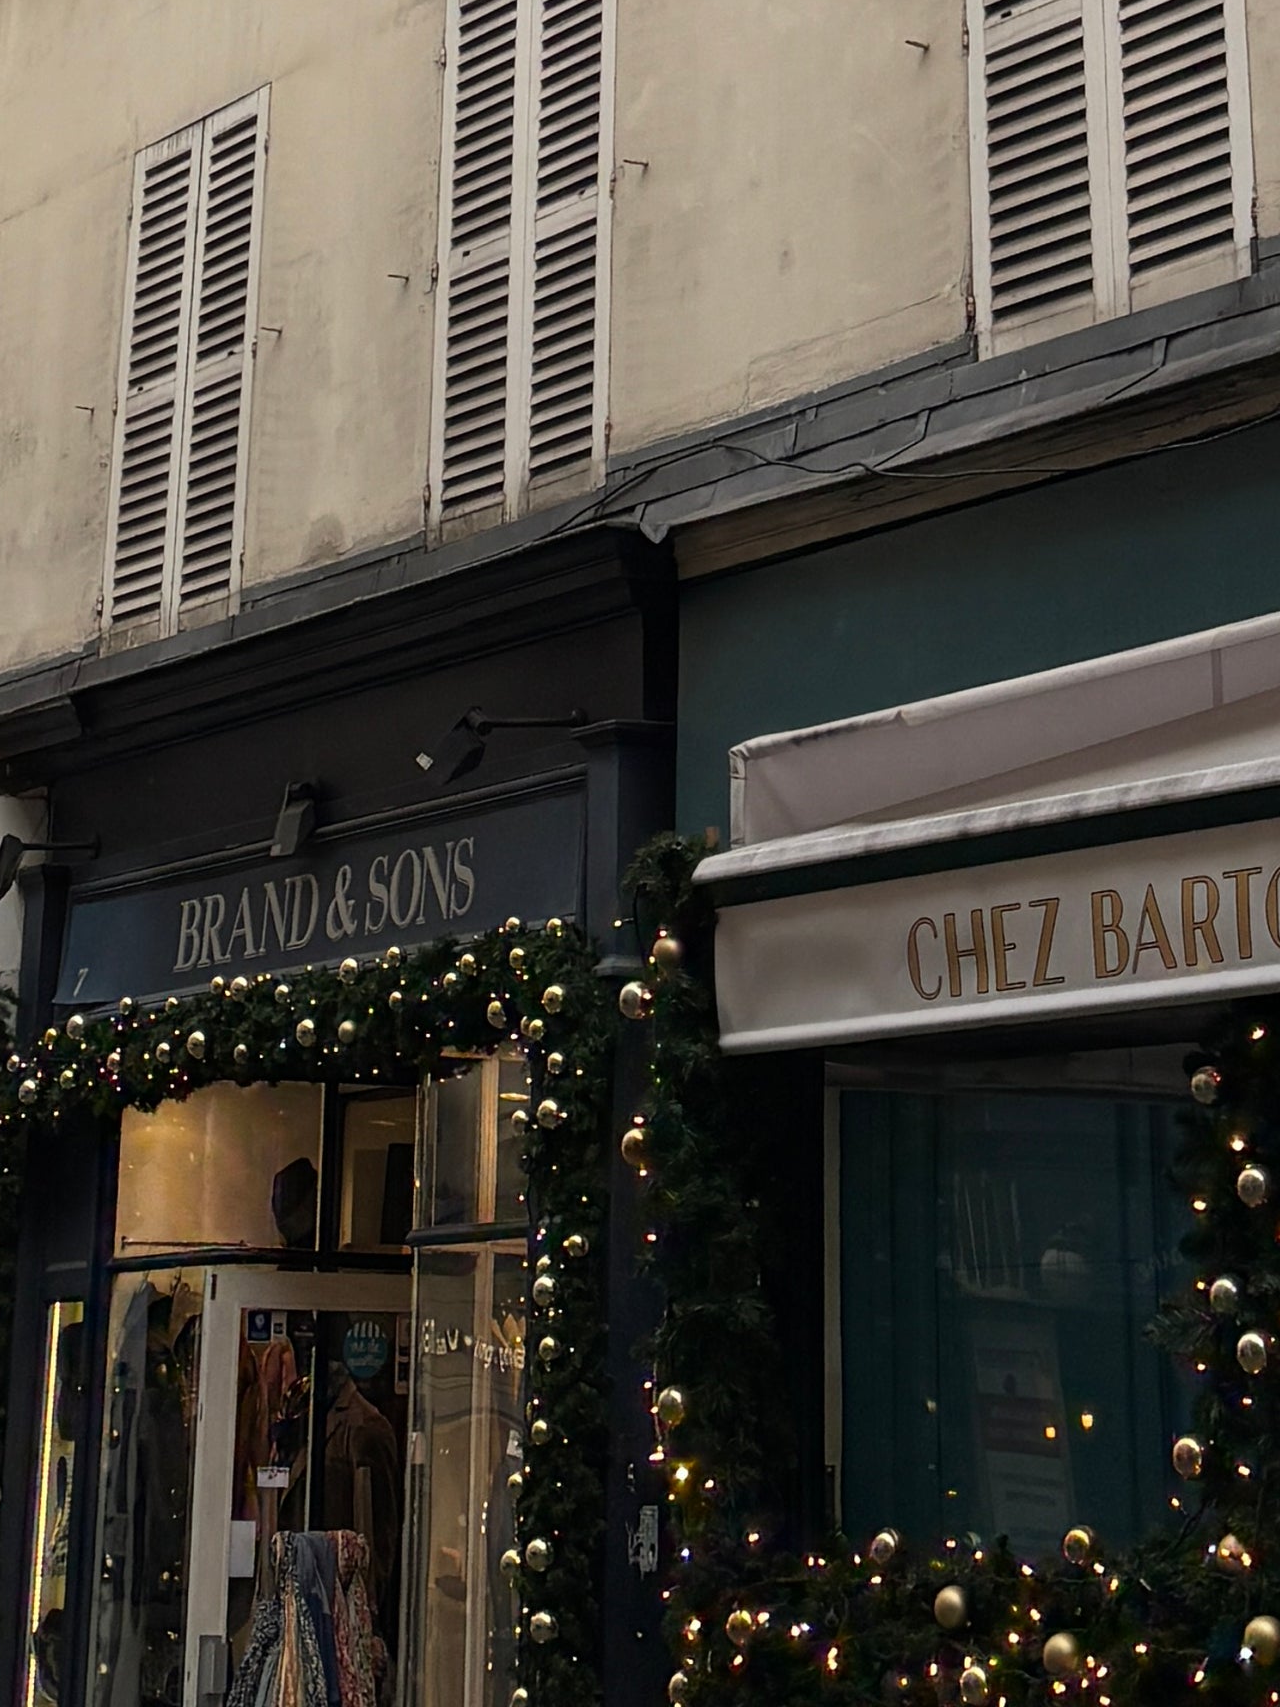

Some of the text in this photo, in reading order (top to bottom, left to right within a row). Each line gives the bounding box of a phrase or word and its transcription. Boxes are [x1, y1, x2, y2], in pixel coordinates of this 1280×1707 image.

[172, 836, 475, 973] BRAND & SONS
[906, 897, 1066, 1000] CHEZ
[72, 967, 89, 997] 7
